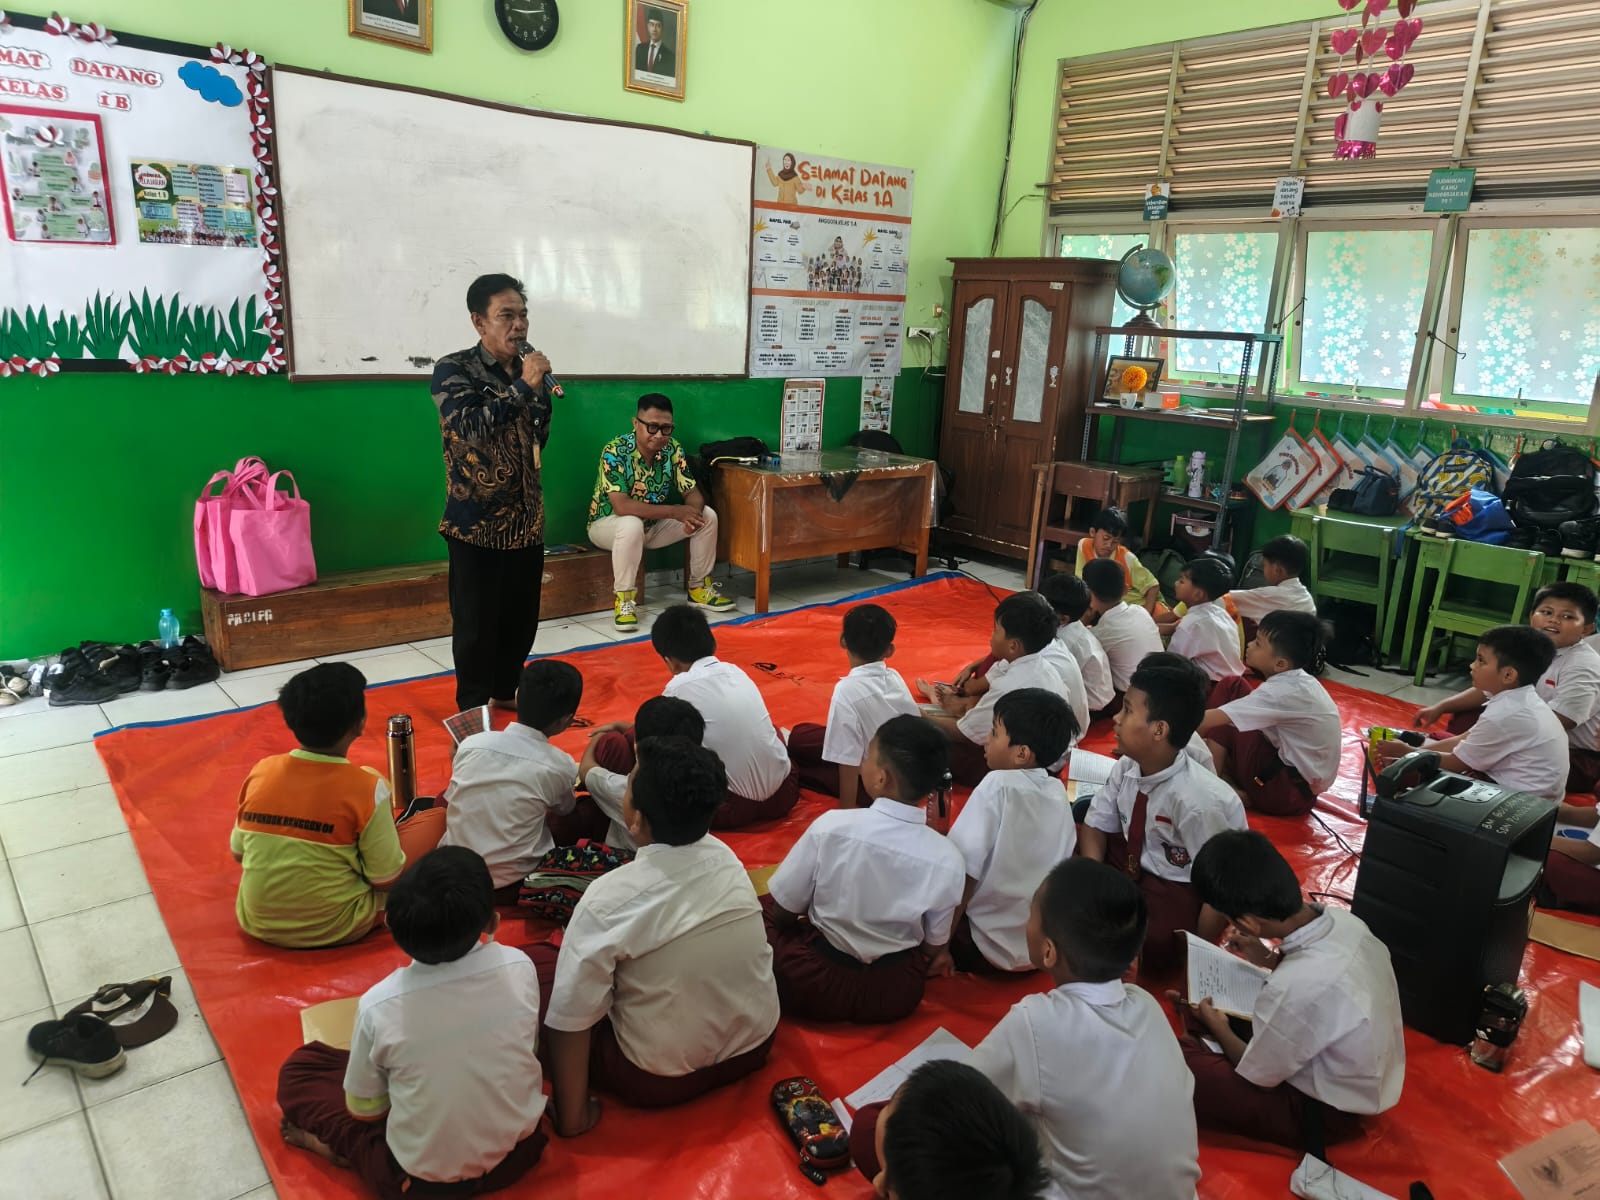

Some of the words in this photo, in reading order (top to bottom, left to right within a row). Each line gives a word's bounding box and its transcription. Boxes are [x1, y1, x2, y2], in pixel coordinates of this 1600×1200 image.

[73, 59, 158, 86] DATANG
[798, 161, 855, 185] SELAMAT
[860, 169, 907, 189] DATANG
[815, 186, 826, 198] DI
[831, 184, 868, 204] KELAS
